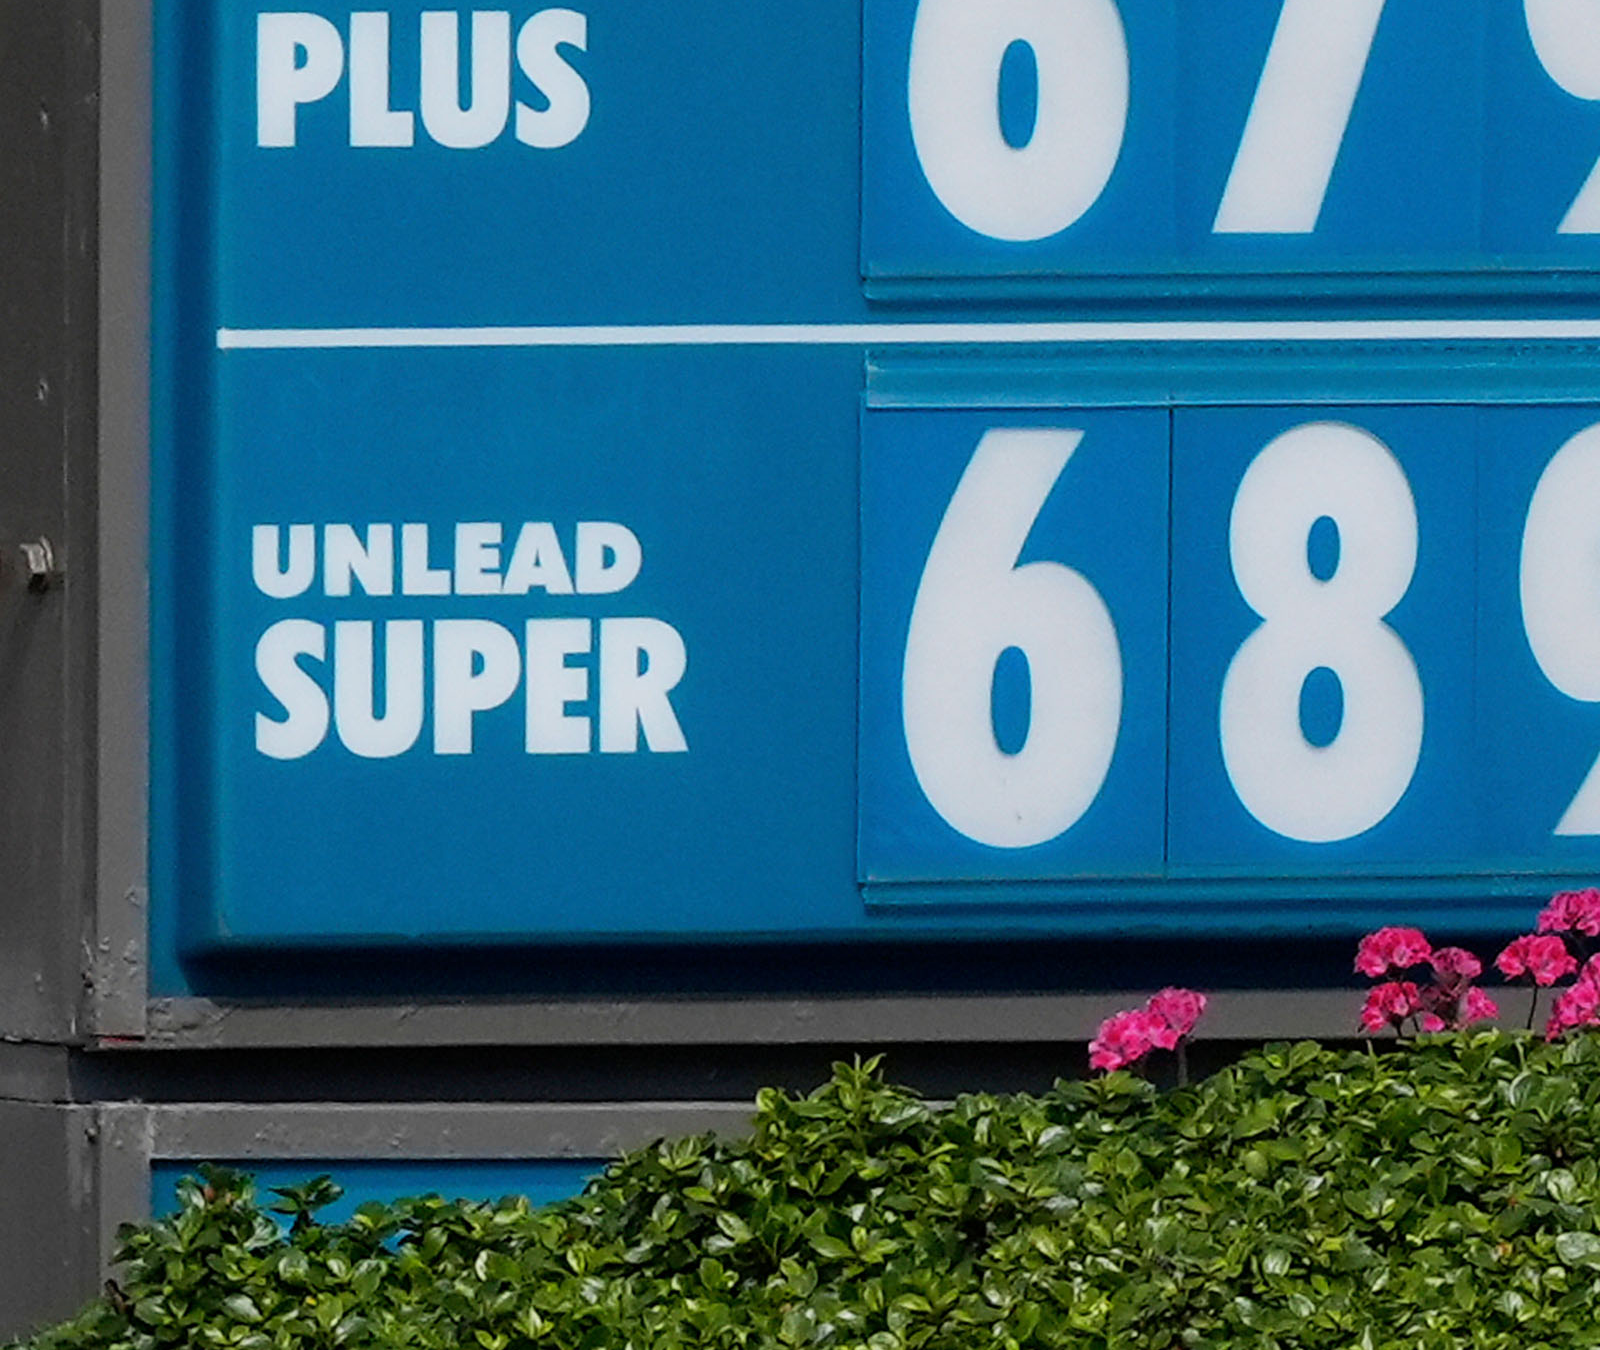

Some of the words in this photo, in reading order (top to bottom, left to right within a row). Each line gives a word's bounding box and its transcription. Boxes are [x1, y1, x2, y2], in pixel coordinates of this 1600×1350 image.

[256, 8, 591, 149] PLUS
[252, 521, 643, 599] UNLEAD
[254, 616, 688, 760] SUPER
